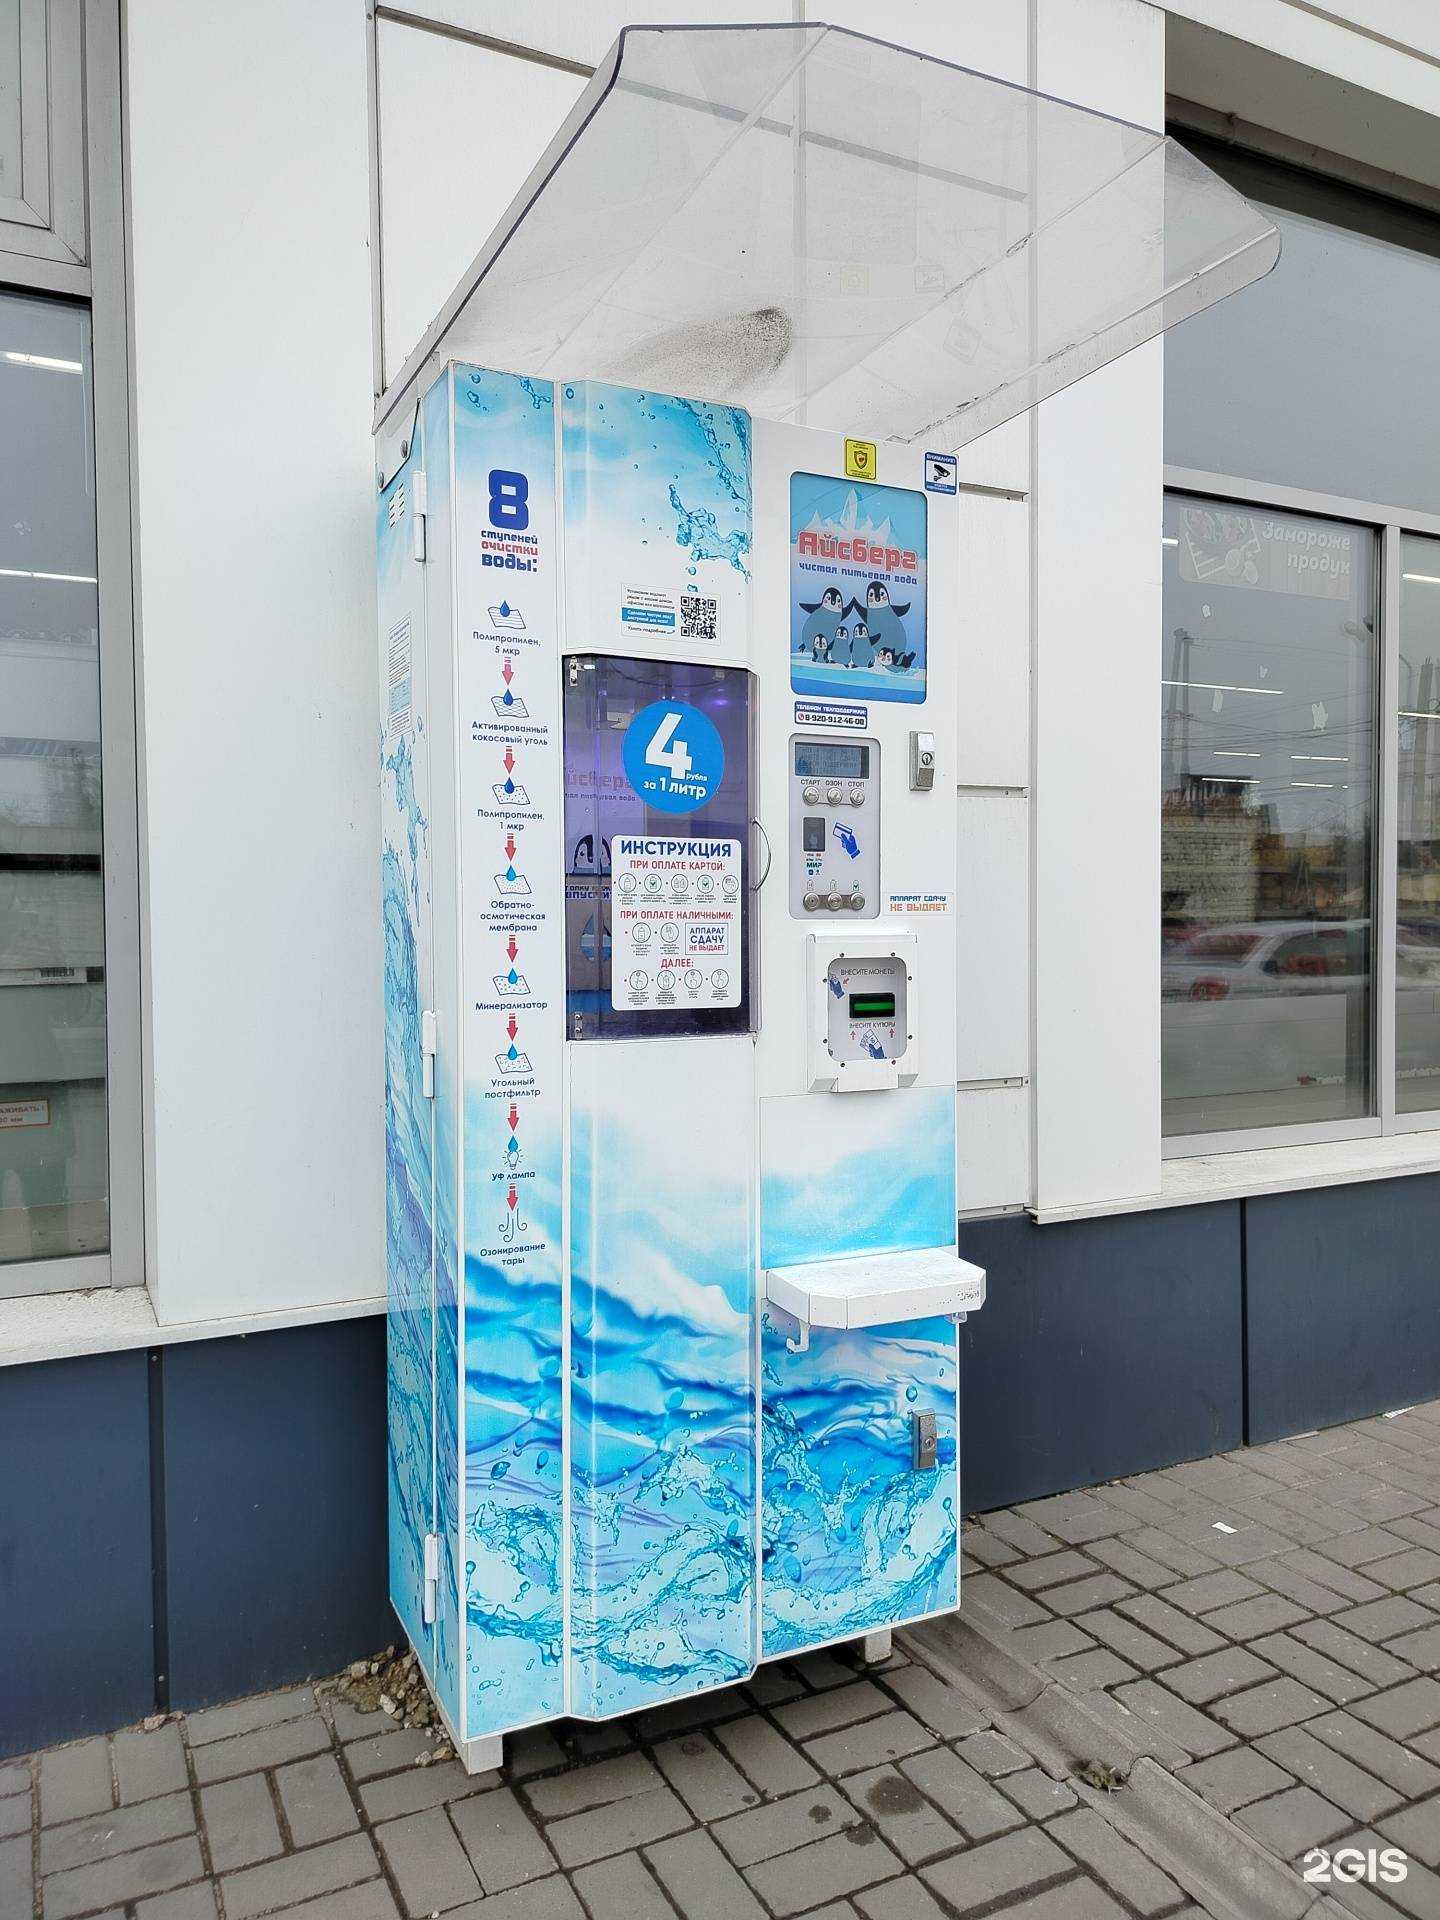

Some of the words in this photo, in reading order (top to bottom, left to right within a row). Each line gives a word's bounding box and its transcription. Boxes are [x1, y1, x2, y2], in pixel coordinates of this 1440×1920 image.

[488, 469, 529, 531] 8
[481, 529, 538, 545] ступеней
[481, 541, 538, 556] очистки
[798, 530, 919, 572] Айсберг
[481, 553, 538, 573] воды:
[799, 562, 837, 575] чистая
[841, 567, 891, 581] питьевая
[894, 574, 918, 585] вода
[473, 631, 541, 647] Полипропилен,
[494, 646, 500, 654] 5
[502, 648, 520, 656] мкр
[471, 721, 548, 734] Активированный
[472, 733, 522, 744] кокосовый
[524, 737, 548, 746] уголь
[645, 712, 693, 780] 4
[686, 772, 708, 782] рубля
[643, 780, 656, 790] за
[659, 777, 667, 791] 1
[668, 781, 707, 800] литр
[825, 779, 843, 787] ОЗОН
[847, 780, 865, 788] СТОП
[477, 809, 545, 821] Полипропилен,
[621, 839, 732, 858] ИНСТРУКЦИЯ
[630, 860, 649, 869] ПРИ
[651, 860, 687, 870] ОПЛАТЕ
[689, 859, 726, 871] КАРТОЙ:
[490, 900, 535, 910] Обратно-
[890, 903, 902, 912] НЕ
[906, 903, 947, 912] ВЫДАЕТ
[620, 910, 638, 920] ПРИ
[640, 910, 674, 920] ОПЛАТЕ
[676, 911, 734, 920] НАЛИЧНЫМИ:
[489, 923, 537, 932] мембрана
[689, 927, 725, 935] АППАРАТ
[690, 935, 725, 945] СДАЧУ
[660, 958, 694, 969] ДАЛЕЕ:
[840, 968, 868, 976] ВНЕСИТЕ
[869, 968, 896, 976] МОНЕТЫ
[475, 1002, 548, 1013] Минерализатор
[491, 1077, 535, 1087] Угольный
[485, 1088, 541, 1099] постфильтр
[506, 1171, 536, 1180] лампа
[480, 1243, 546, 1257] Озонирование
[501, 1258, 525, 1266] тары
